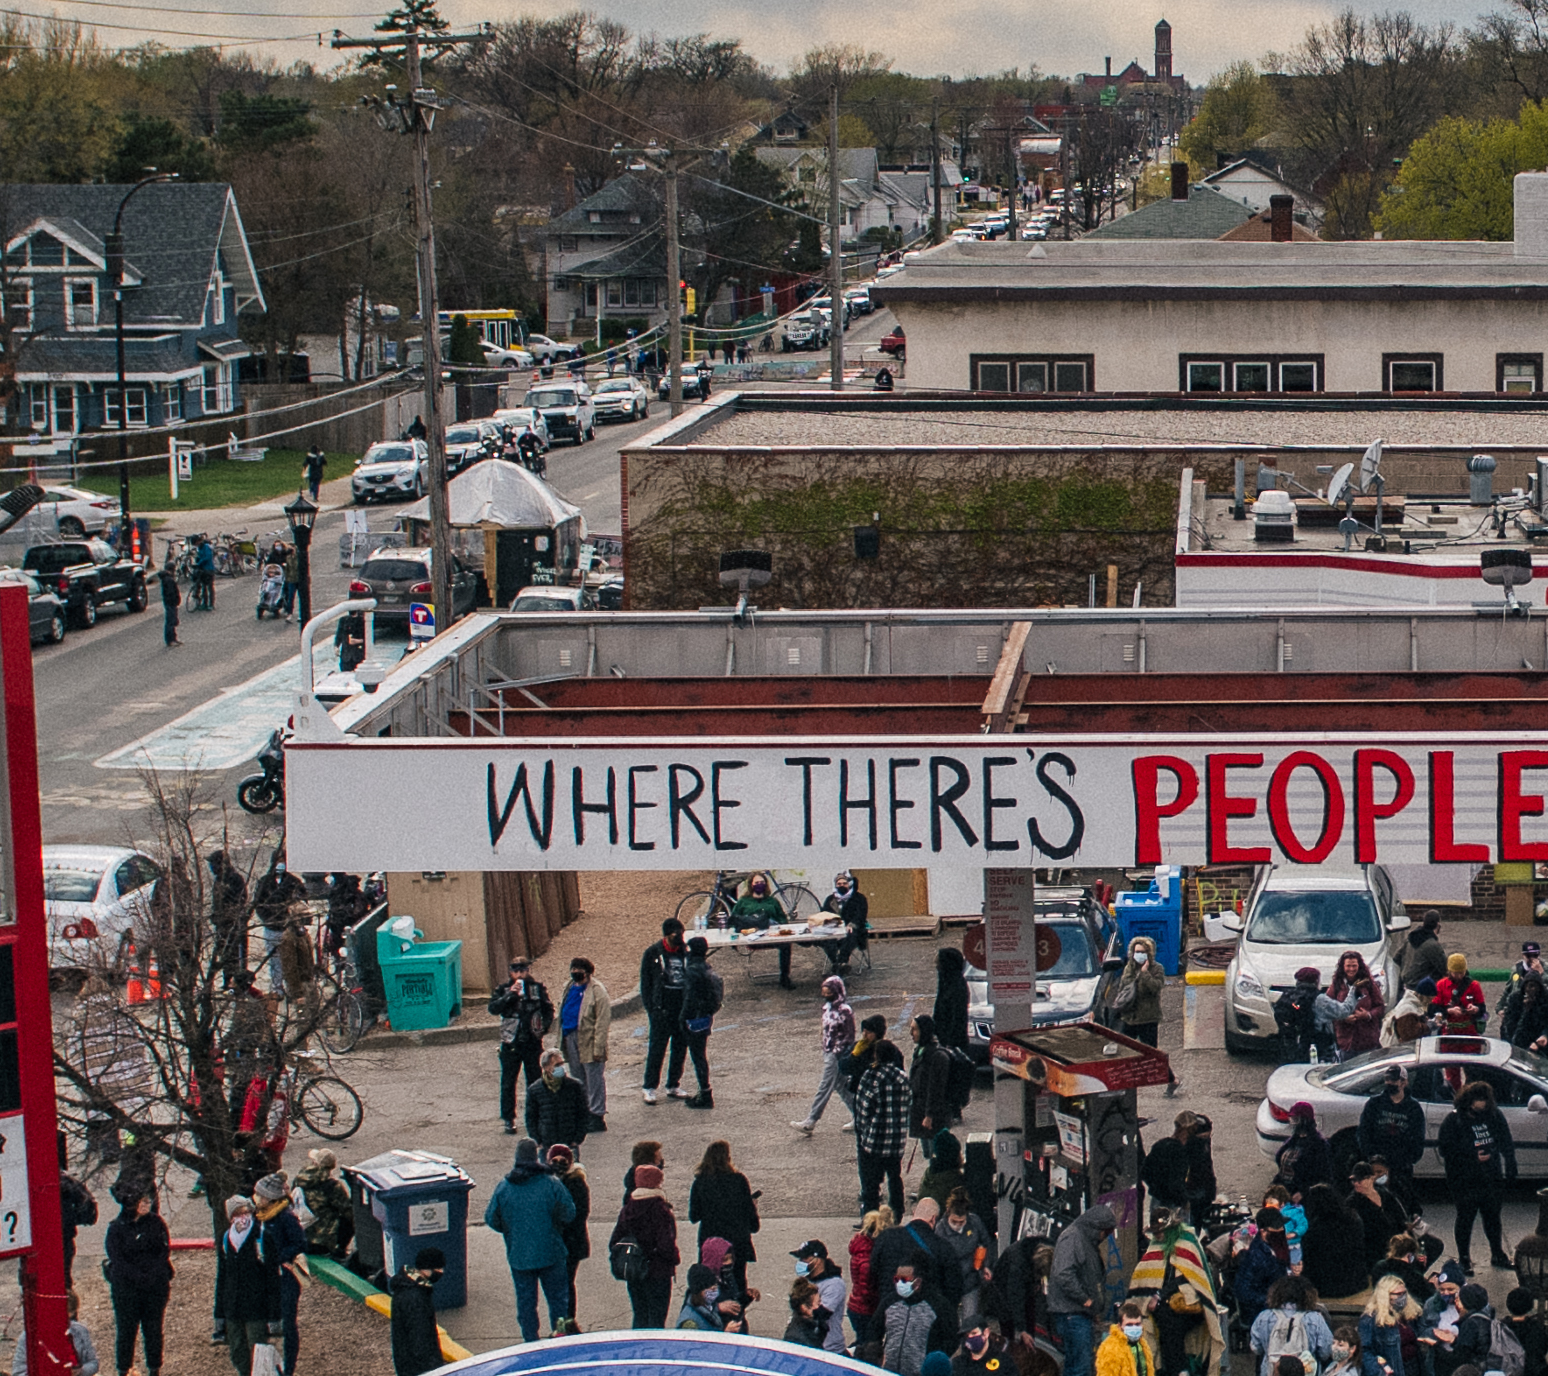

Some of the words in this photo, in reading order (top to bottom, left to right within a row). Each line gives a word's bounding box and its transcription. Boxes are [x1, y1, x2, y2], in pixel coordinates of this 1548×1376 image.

[487, 758, 749, 851] WHERE
[785, 750, 1085, 860] THERE'S
[989, 876, 1026, 886] SERVE
[974, 938, 986, 955] 4
[1037, 939, 1049, 956] 3
